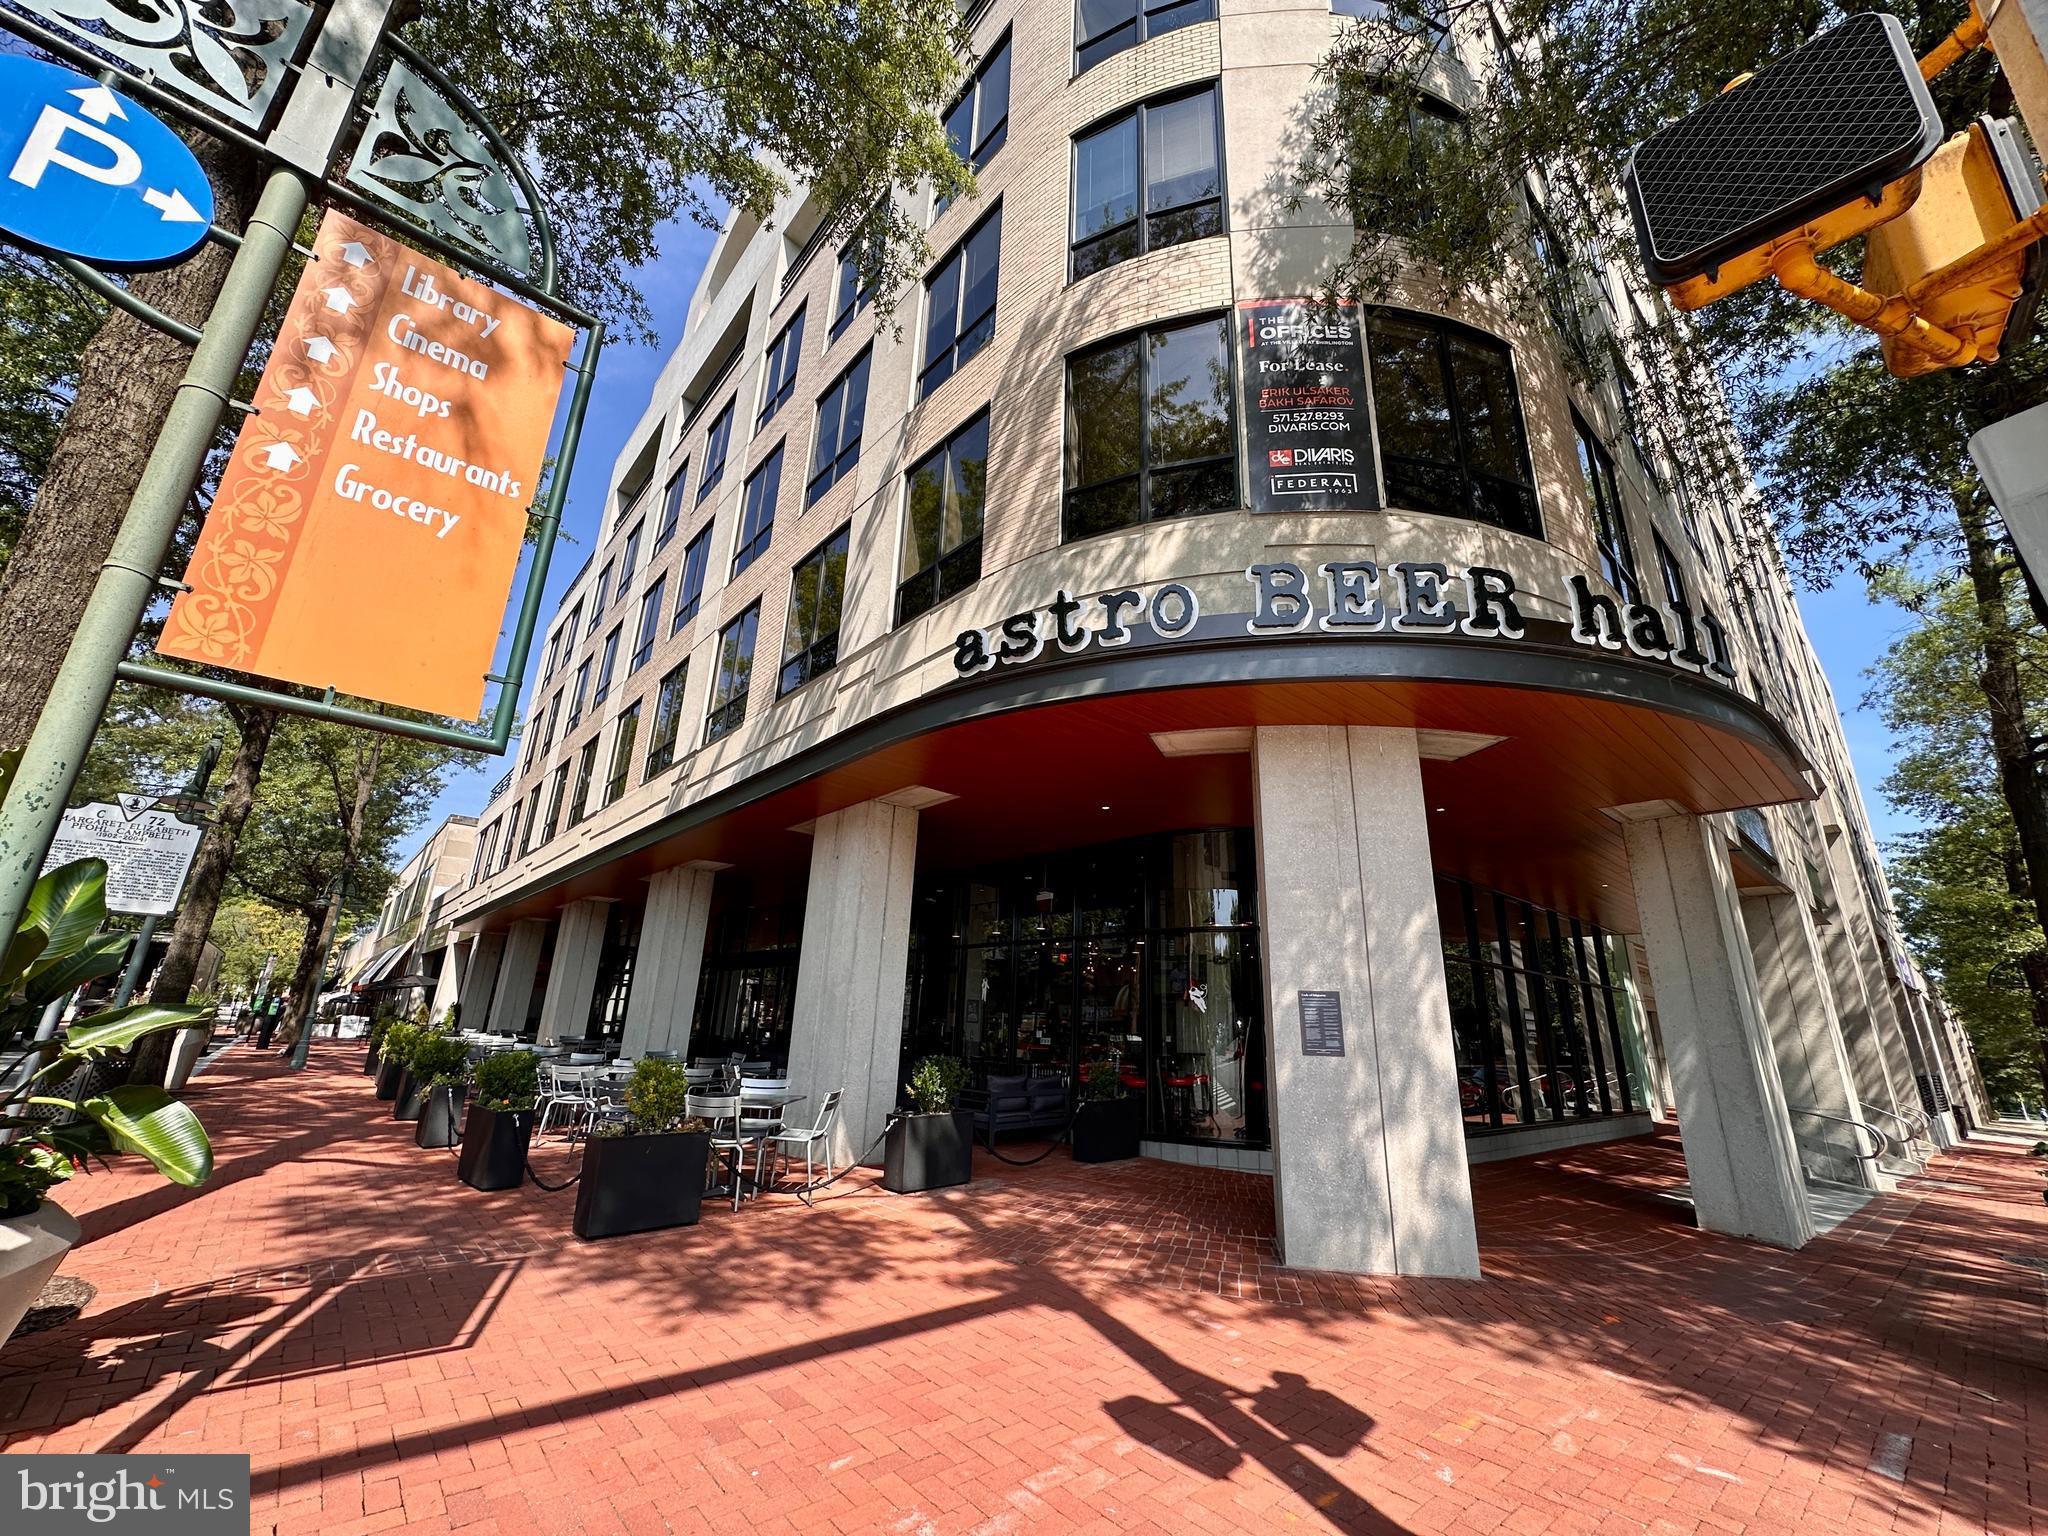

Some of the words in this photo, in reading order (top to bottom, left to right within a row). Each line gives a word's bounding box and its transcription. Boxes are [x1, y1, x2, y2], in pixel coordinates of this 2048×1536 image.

[8, 106, 142, 189] P
[400, 265, 502, 340] Library
[1259, 316, 1284, 325] THE
[1259, 324, 1352, 340] OFFICES
[387, 314, 489, 382] Cinema
[1259, 360, 1289, 373] For
[368, 362, 452, 419] Shops
[1261, 388, 1290, 398] ERIK
[1293, 386, 1350, 396] ULSAKER
[1259, 398, 1294, 408] BAKH
[1297, 396, 1354, 406] SAFAROV
[1272, 411, 1345, 423] 571.527.8293
[1268, 422, 1351, 434] DIVARIS.COM
[350, 410, 522, 500] Restaurants
[1294, 448, 1355, 463] DIVARIS
[1277, 478, 1352, 489] FEDERAL
[333, 463, 461, 539] Grocery
[953, 583, 1200, 678] astro
[1245, 562, 1530, 640] BEER
[1561, 575, 1737, 686] hall
[96, 810, 106, 818] C
[148, 816, 166, 826] 72
[71, 822, 110, 832] PFOHL
[116, 828, 174, 840] CAMPBELL
[129, 822, 190, 836] ELIZABETH
[96, 832, 148, 842] (1902-2004)
